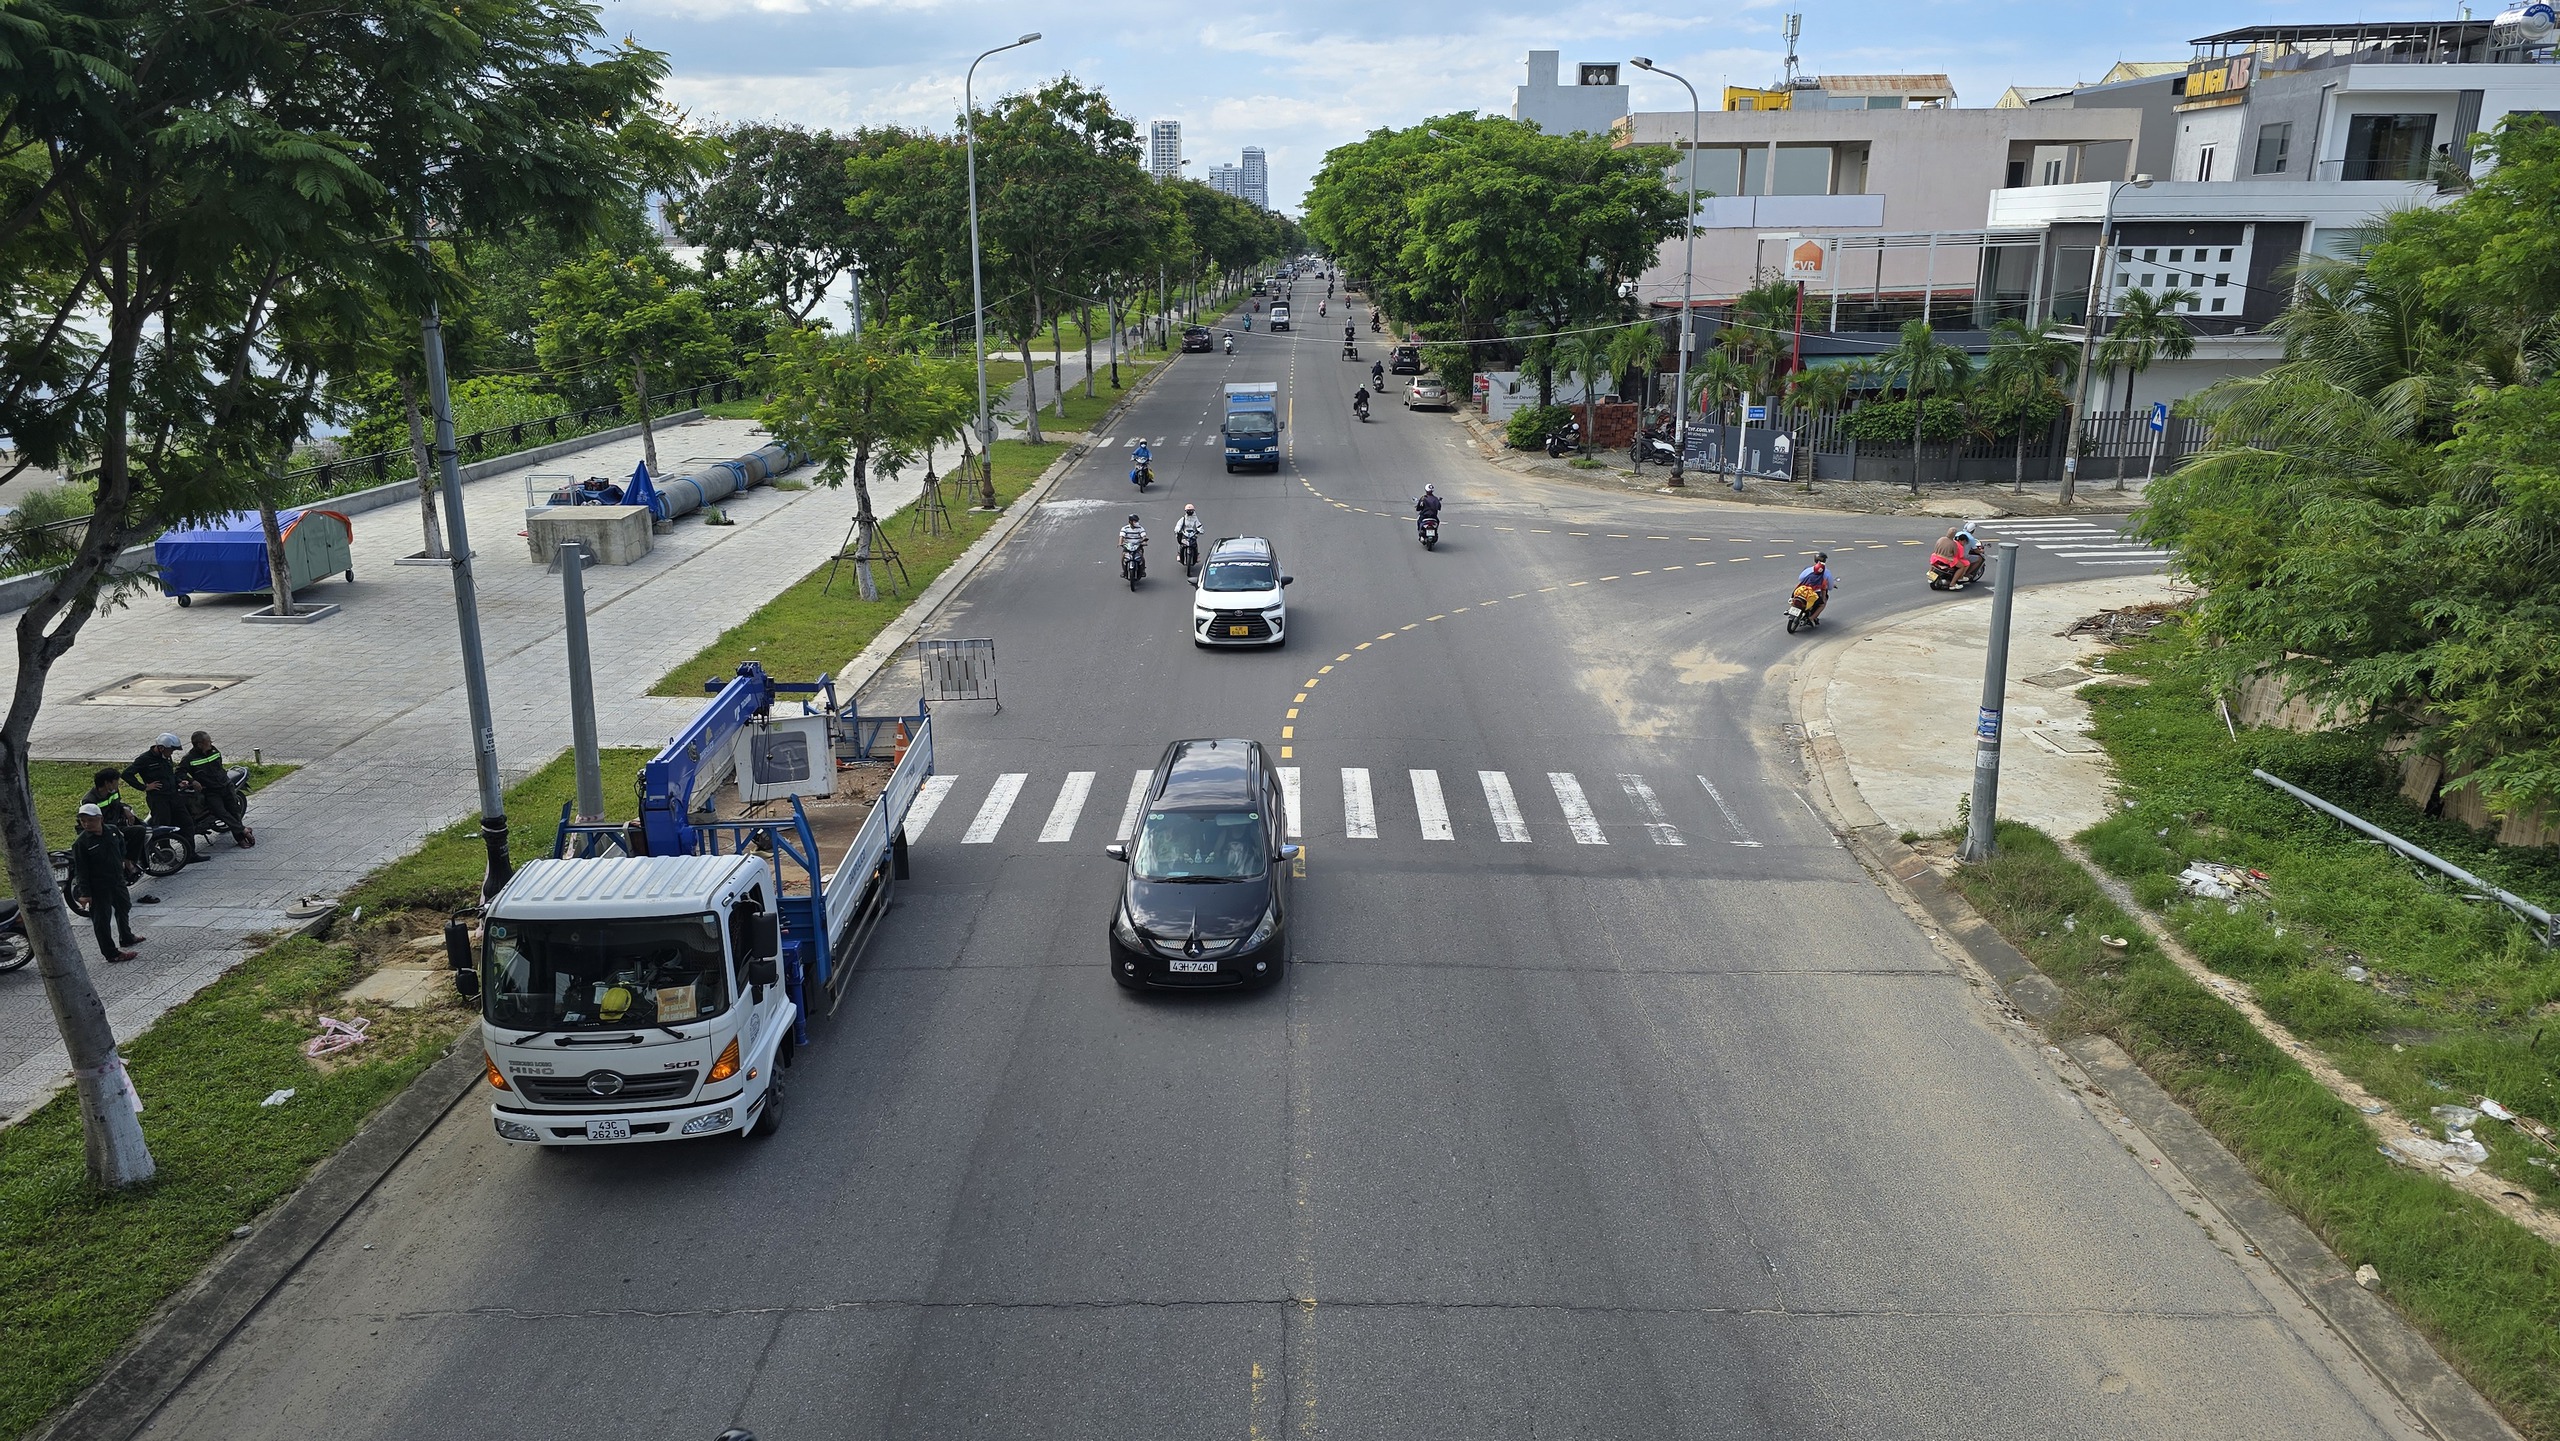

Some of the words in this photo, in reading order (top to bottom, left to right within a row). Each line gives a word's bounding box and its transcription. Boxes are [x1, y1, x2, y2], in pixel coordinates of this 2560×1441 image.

[2185, 63, 2205, 98] NHÀ
[2226, 57, 2251, 91] AB
[1792, 260, 1816, 271] CVR
[664, 1060, 699, 1070] 500
[509, 1066, 555, 1075] HINO
[598, 1121, 618, 1130] 43C
[592, 1129, 627, 1139] 262.99
